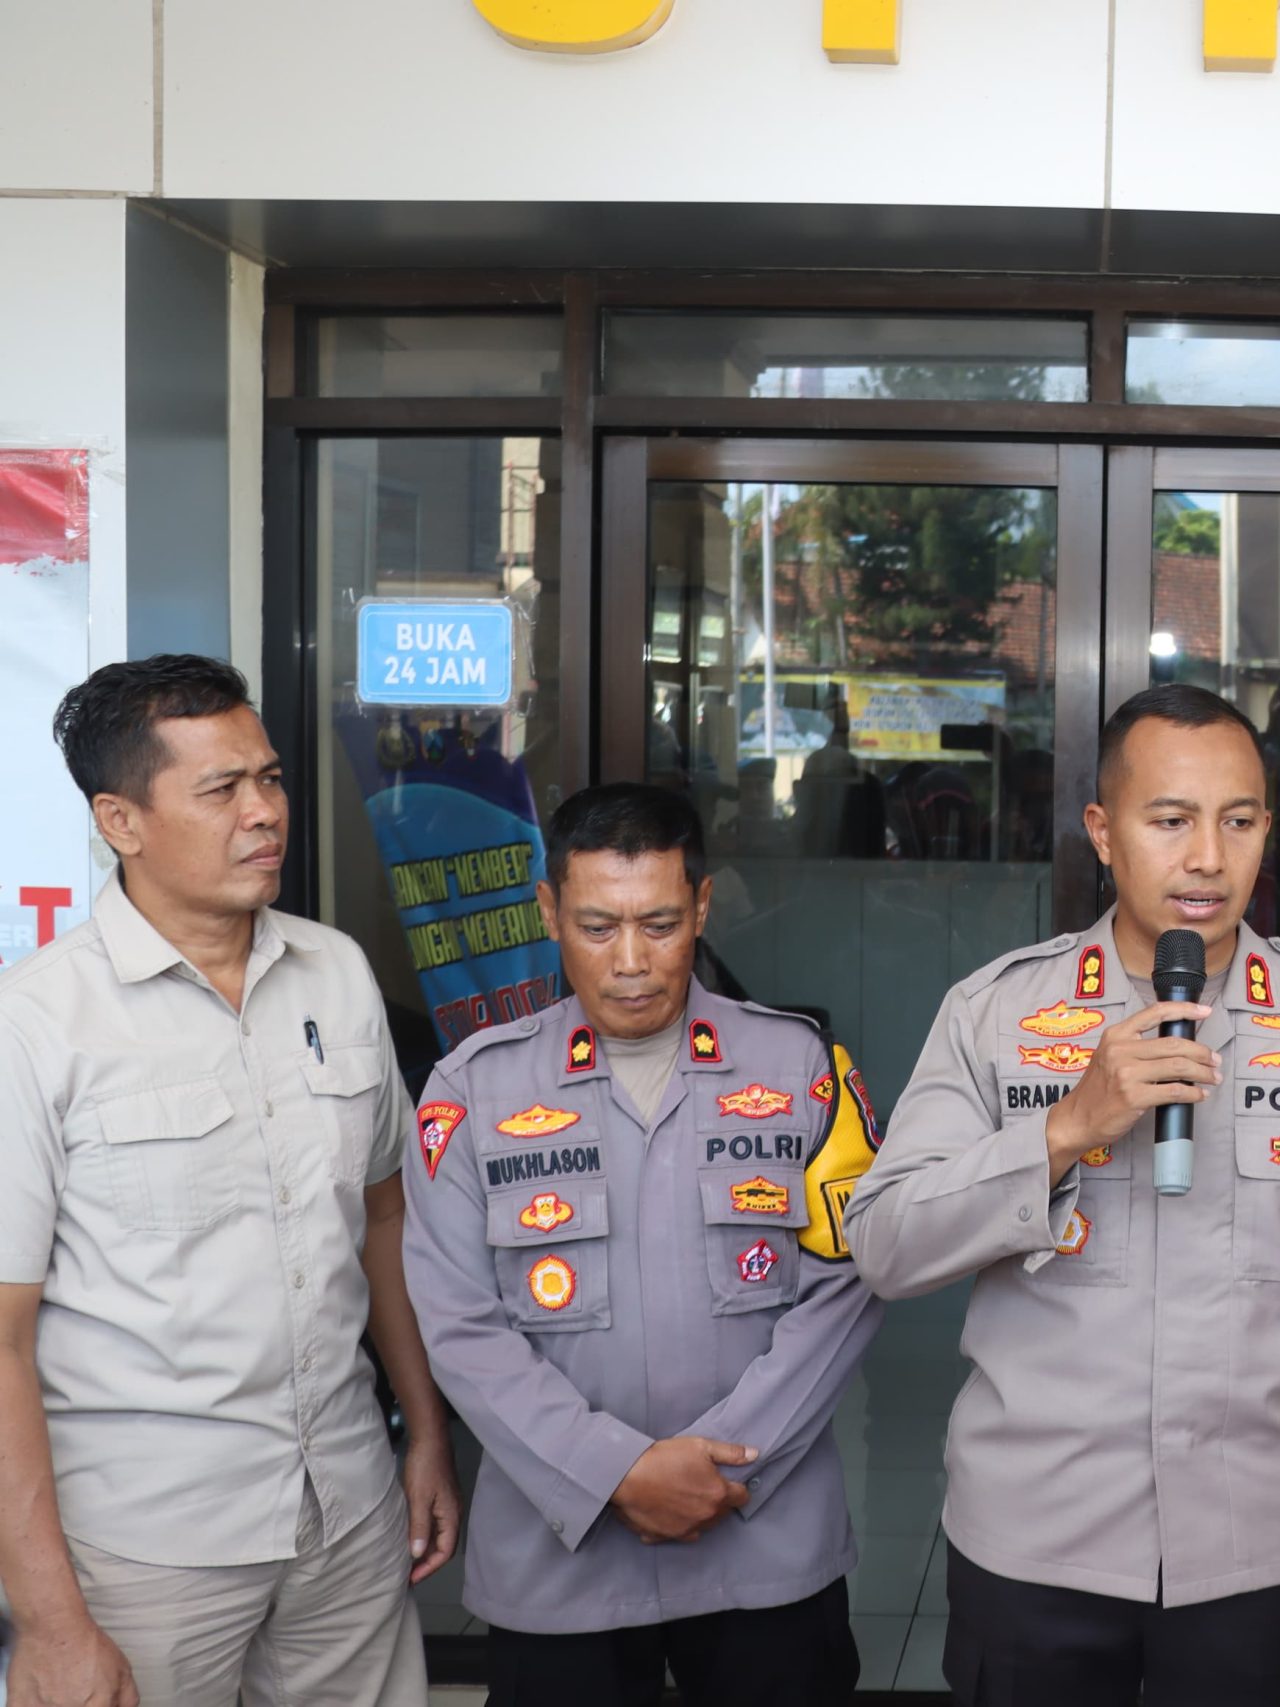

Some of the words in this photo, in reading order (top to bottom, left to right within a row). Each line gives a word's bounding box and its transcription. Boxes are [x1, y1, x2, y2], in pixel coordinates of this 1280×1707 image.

[396, 622, 476, 651] BUKA
[384, 656, 417, 685] 24
[425, 656, 486, 686] JAM
[706, 1134, 802, 1162] POLRI
[486, 1146, 601, 1187] MUKHLASON
